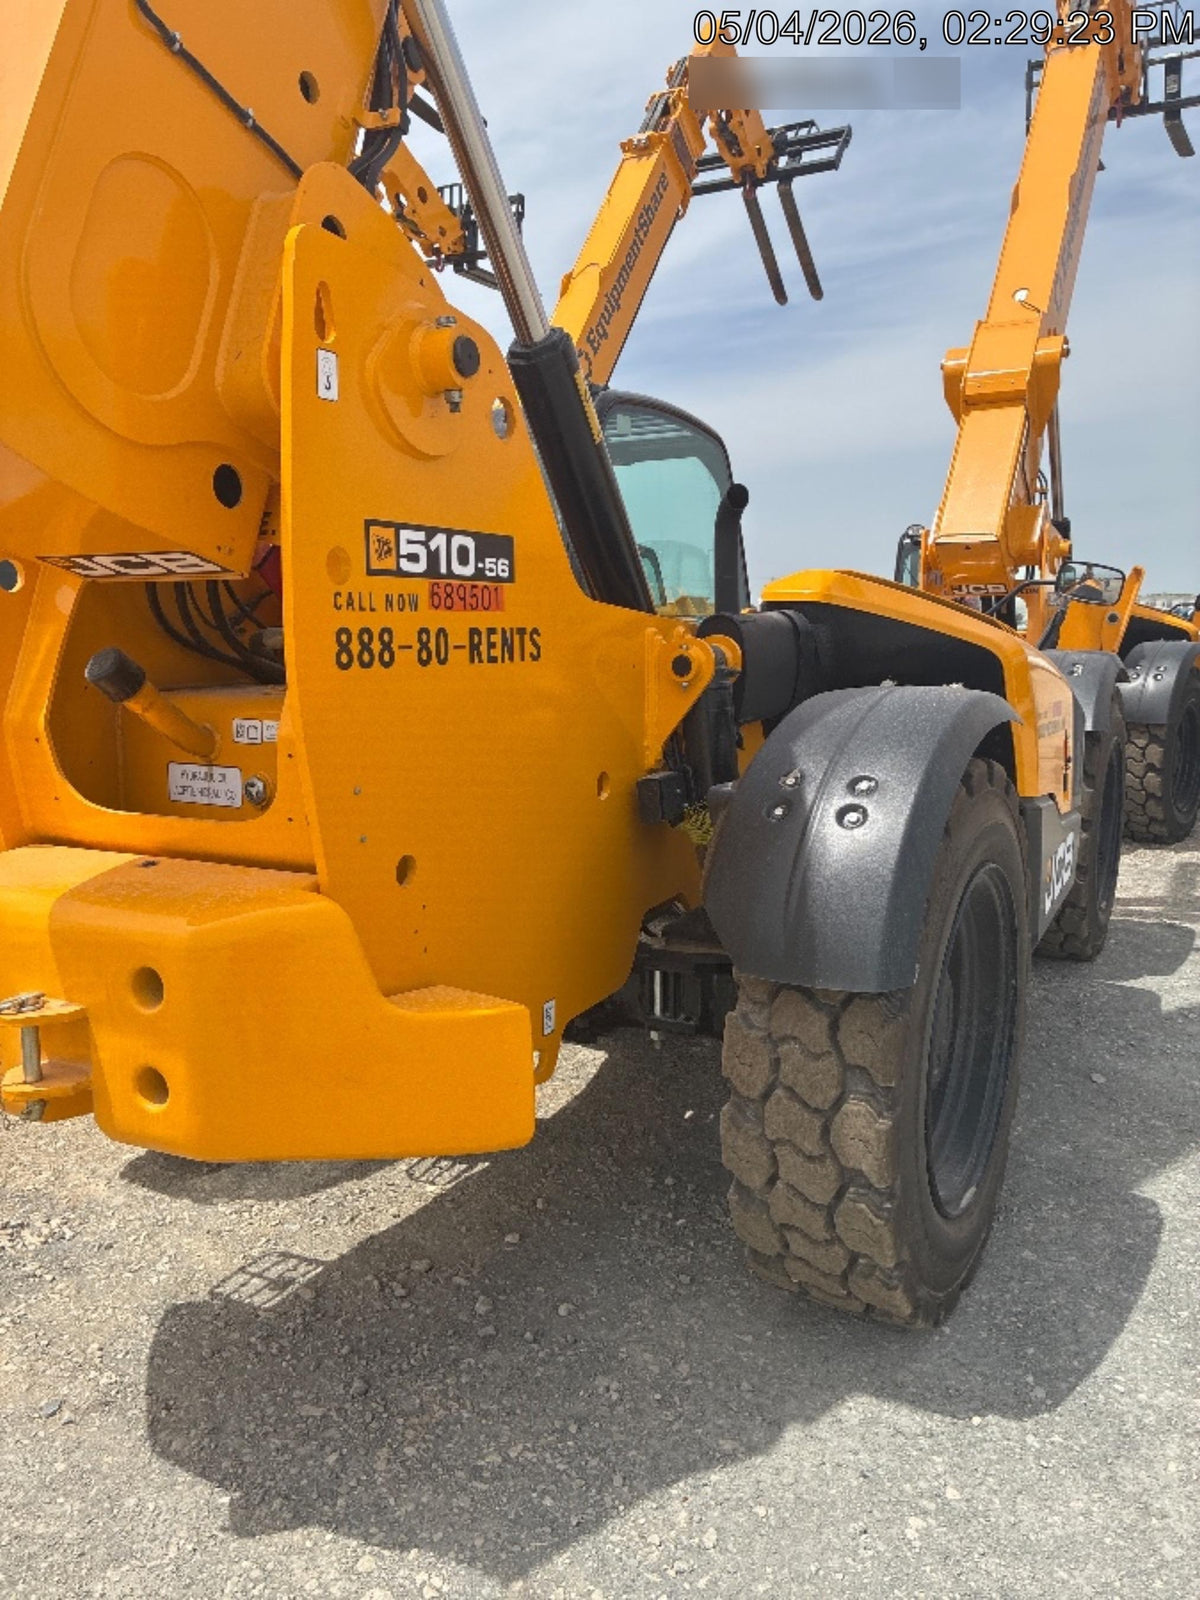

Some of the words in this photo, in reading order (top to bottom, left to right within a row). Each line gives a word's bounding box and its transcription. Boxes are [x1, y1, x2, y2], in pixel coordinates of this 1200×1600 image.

[586, 171, 670, 357] EquipmentShare
[68, 552, 223, 577] JCB
[333, 591, 377, 613] CALL
[384, 593, 420, 613] NOW
[429, 582, 501, 611] 689501
[952, 583, 1008, 596] JCB
[334, 626, 542, 671] 888-80-RENTS
[1045, 831, 1075, 916] JCB
